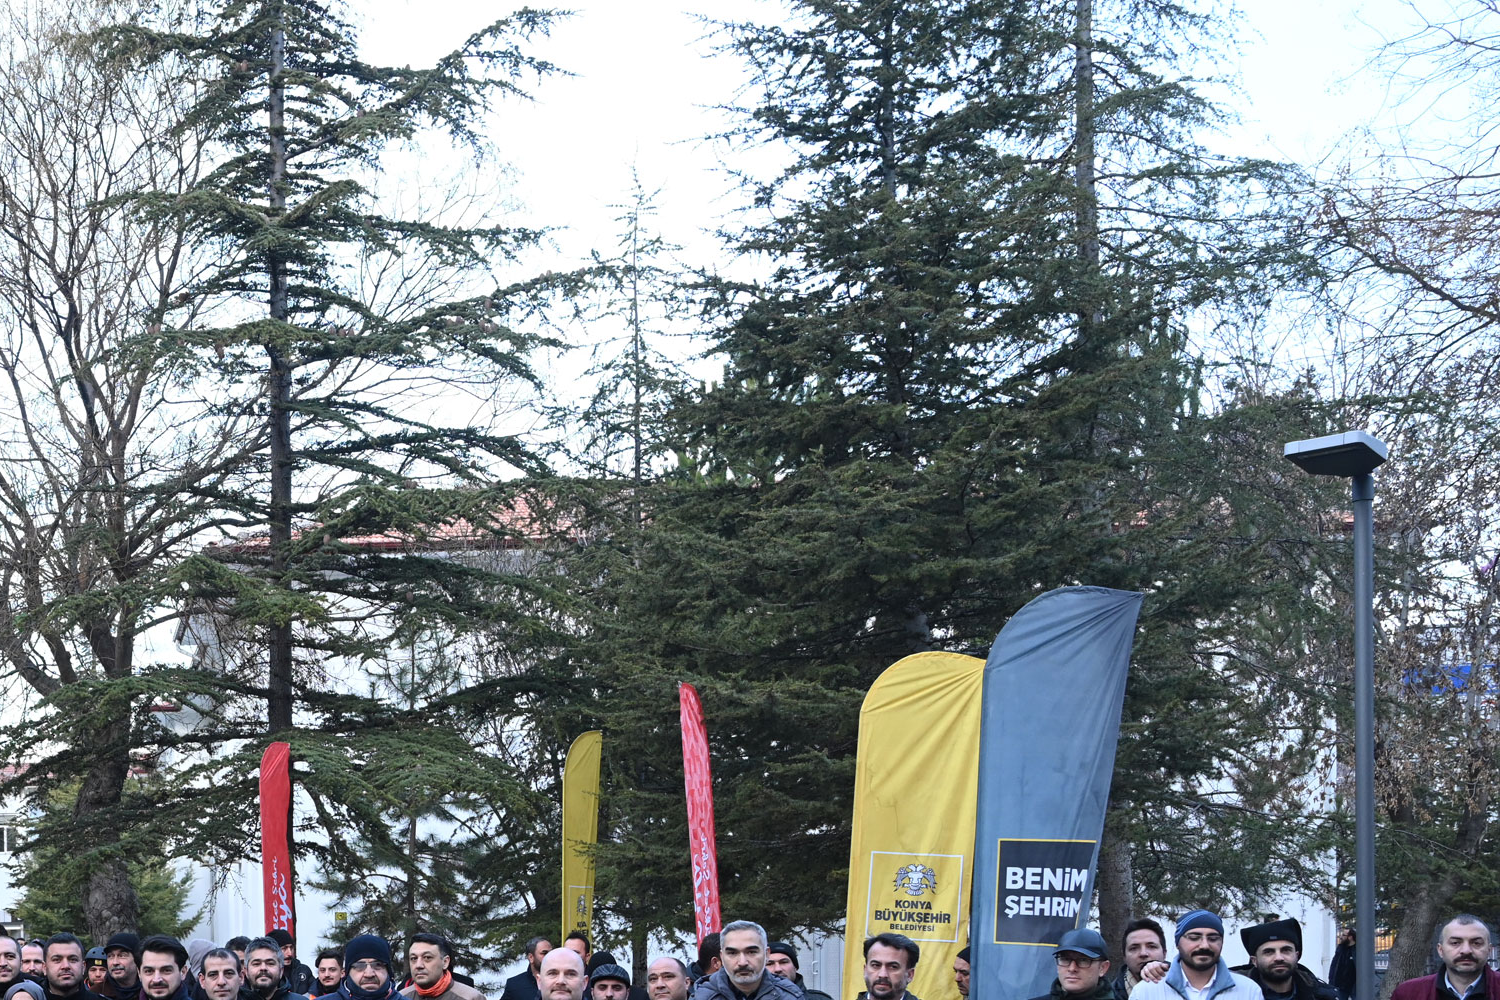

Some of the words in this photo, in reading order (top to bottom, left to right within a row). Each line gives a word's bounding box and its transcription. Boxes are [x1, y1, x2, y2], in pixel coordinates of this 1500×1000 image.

[1005, 866, 1088, 892] BENİM
[894, 899, 932, 910] KONYA
[874, 908, 951, 924] BÜYÜKŞEHİR
[889, 923, 935, 932] BELEDİYESİ
